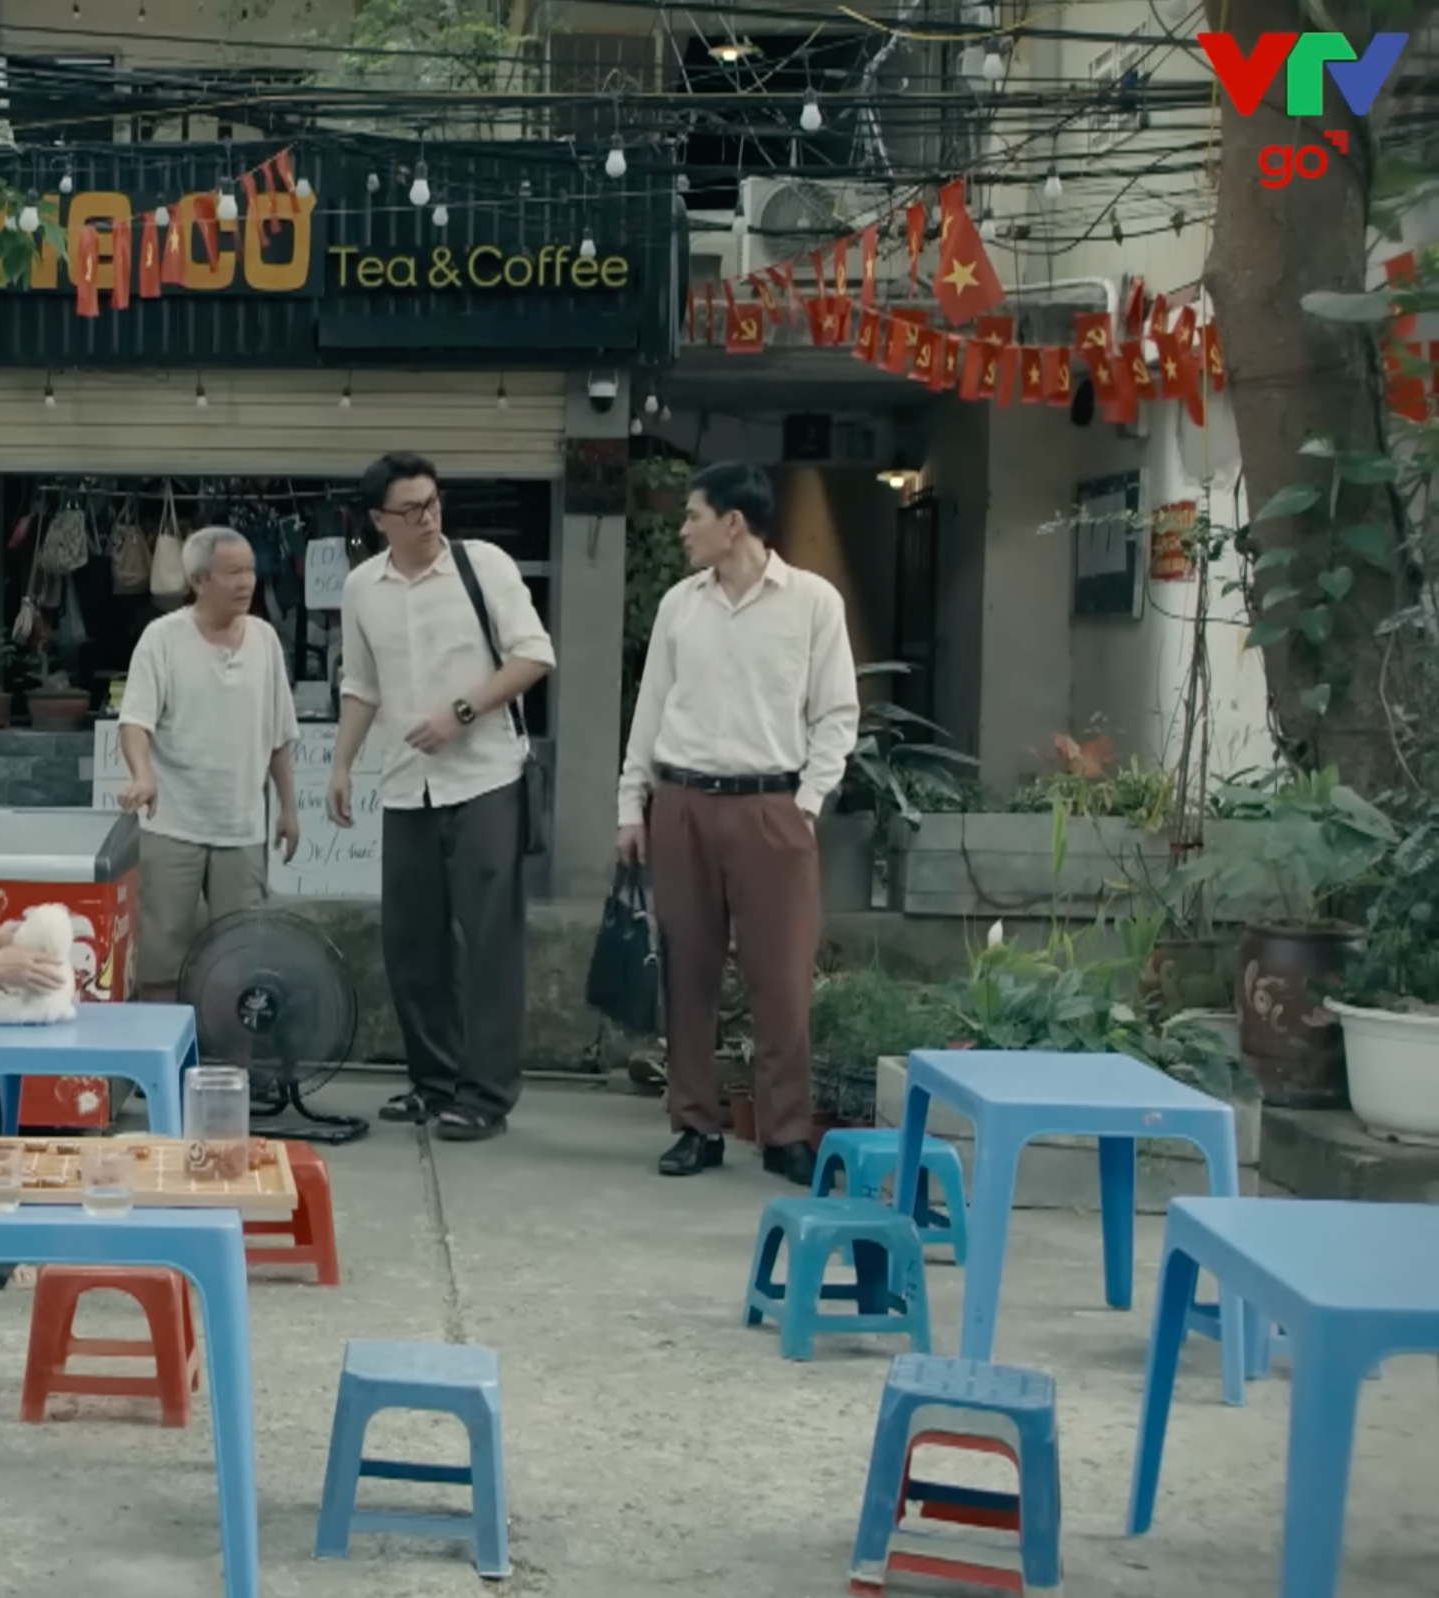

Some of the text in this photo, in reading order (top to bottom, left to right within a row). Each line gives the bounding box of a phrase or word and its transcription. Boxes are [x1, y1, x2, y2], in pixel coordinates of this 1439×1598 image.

[327, 245, 629, 288] Tea & Coffee
